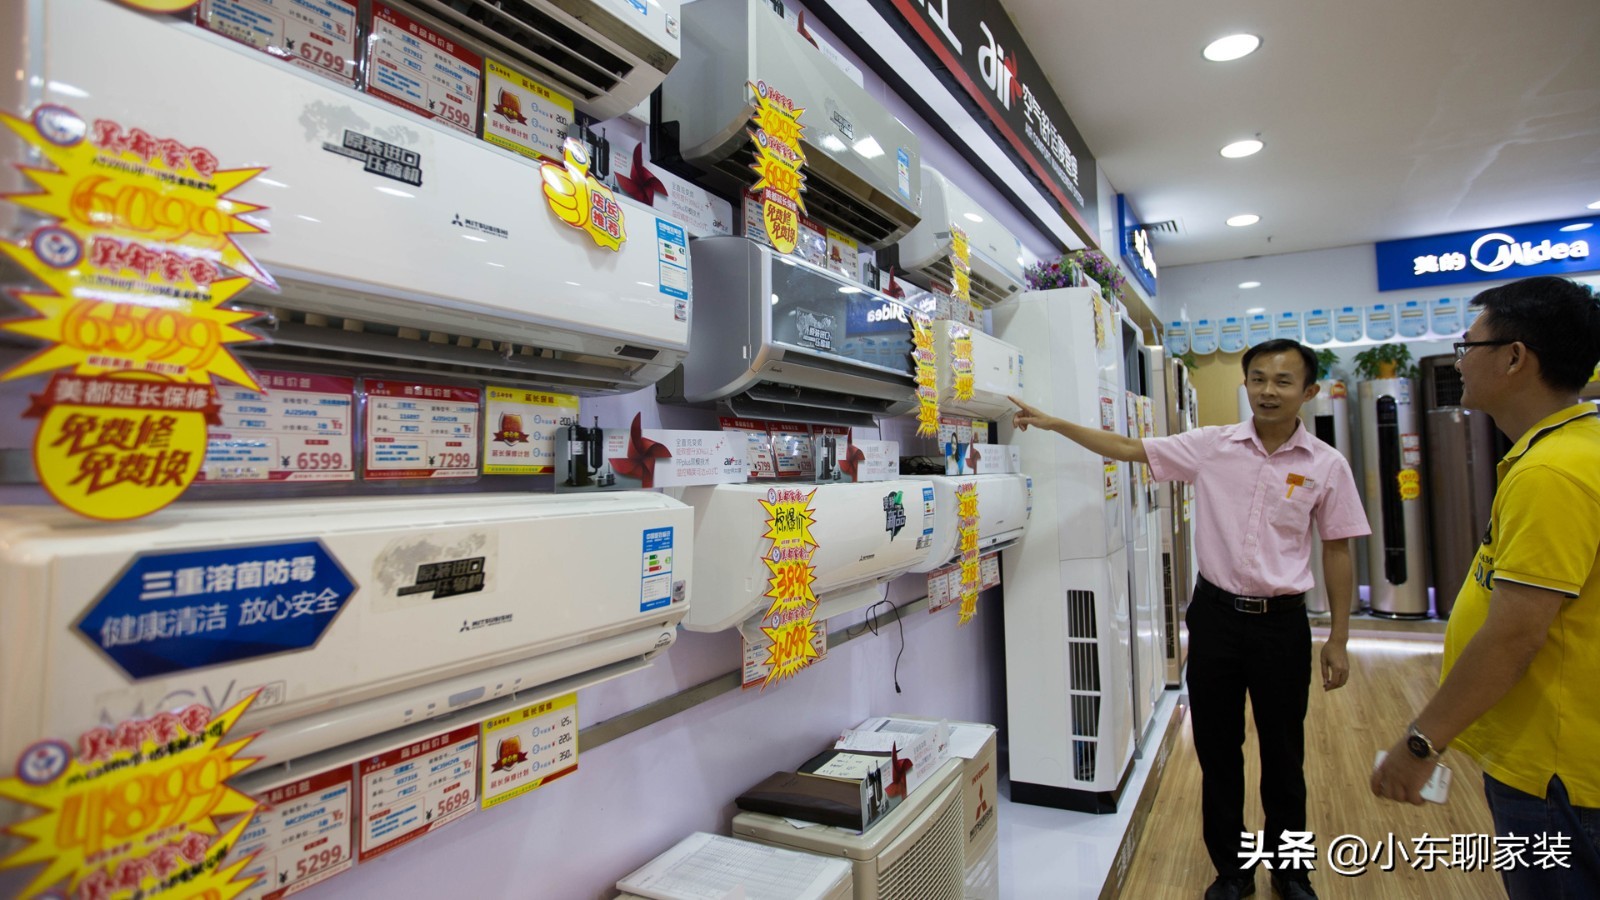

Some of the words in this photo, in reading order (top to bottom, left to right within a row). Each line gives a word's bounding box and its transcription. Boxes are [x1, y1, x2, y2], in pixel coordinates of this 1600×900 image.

[300, 42, 346, 73] 6799
[439, 101, 470, 127] 7599
[344, 131, 420, 168] 原装进口
[592, 192, 619, 219] 店长
[465, 218, 509, 236] MITSUBISHI
[1470, 232, 1590, 272] Midea
[61, 298, 222, 370] 6599
[54, 377, 209, 409] 美都延长保修
[50, 412, 178, 457] 免费修
[68, 449, 192, 496] 免费换
[297, 452, 343, 470] 6599
[438, 452, 470, 468] 7299
[139, 555, 317, 601] 三重溶菌防霉
[101, 602, 229, 648] 健康清洁
[238, 587, 340, 626] 放心安全
[472, 613, 513, 627] MITSUBISHI
[774, 625, 808, 669] 4099
[437, 789, 470, 817] 5699
[296, 844, 342, 880] 5299
